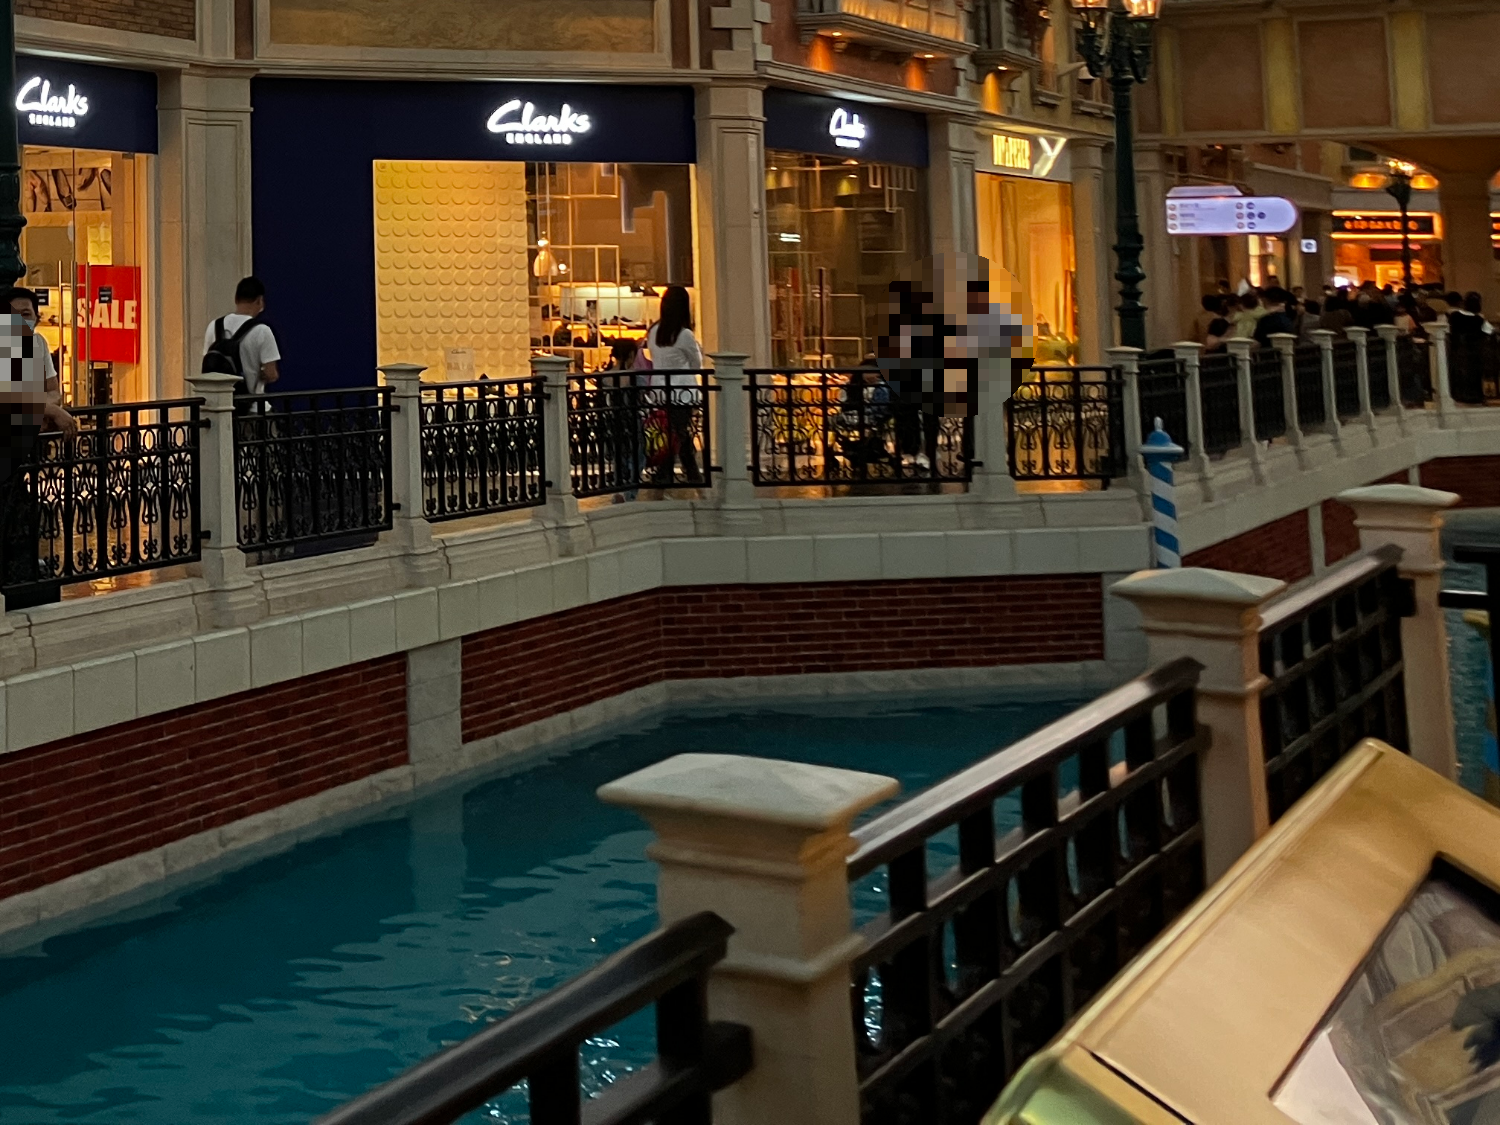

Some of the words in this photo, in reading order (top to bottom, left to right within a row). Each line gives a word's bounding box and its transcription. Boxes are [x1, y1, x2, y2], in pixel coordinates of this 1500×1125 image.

[15, 76, 89, 116] Clarks
[487, 99, 591, 133] Clarks
[76, 297, 138, 330] SALE
